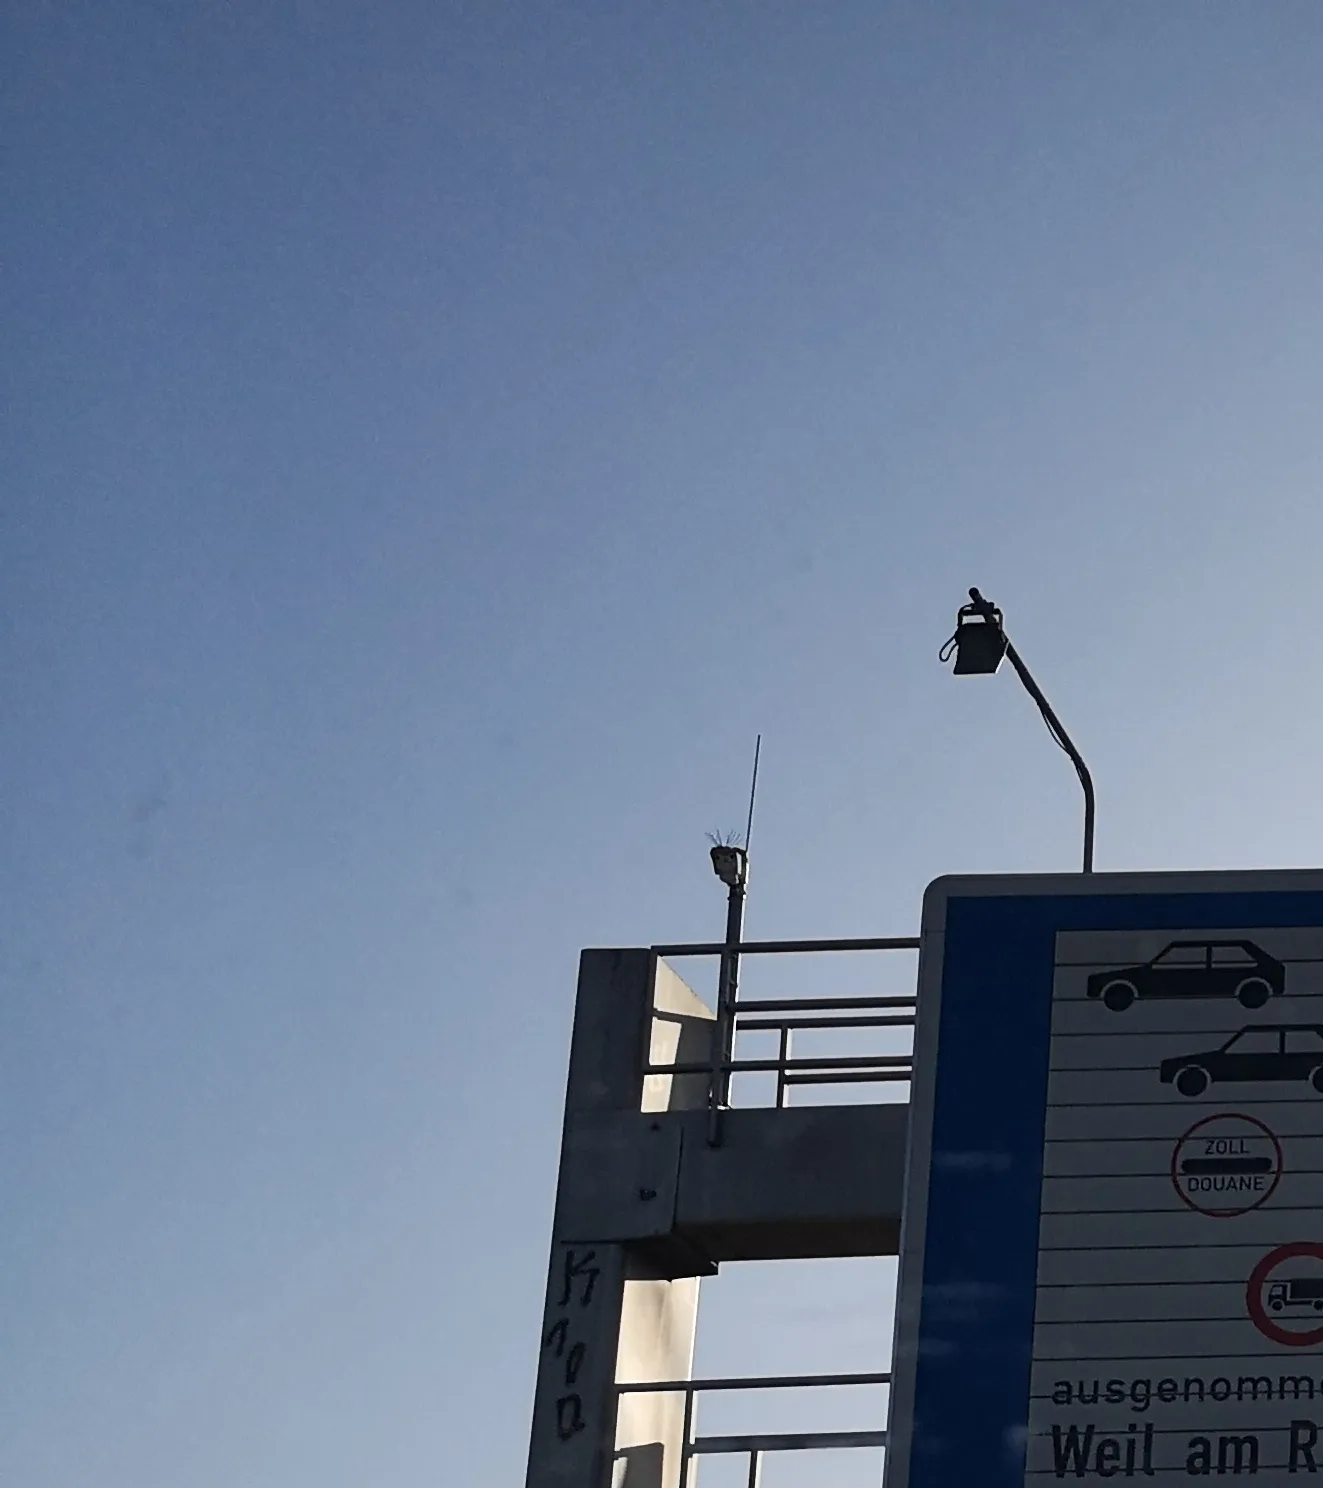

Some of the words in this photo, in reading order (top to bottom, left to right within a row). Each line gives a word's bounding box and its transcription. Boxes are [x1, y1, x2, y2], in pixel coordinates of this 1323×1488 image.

[1203, 1139, 1251, 1155] ZOLL
[1187, 1176, 1265, 1192] DOUANE
[1050, 1422, 1155, 1478] Weil
[1185, 1428, 1259, 1475] am
